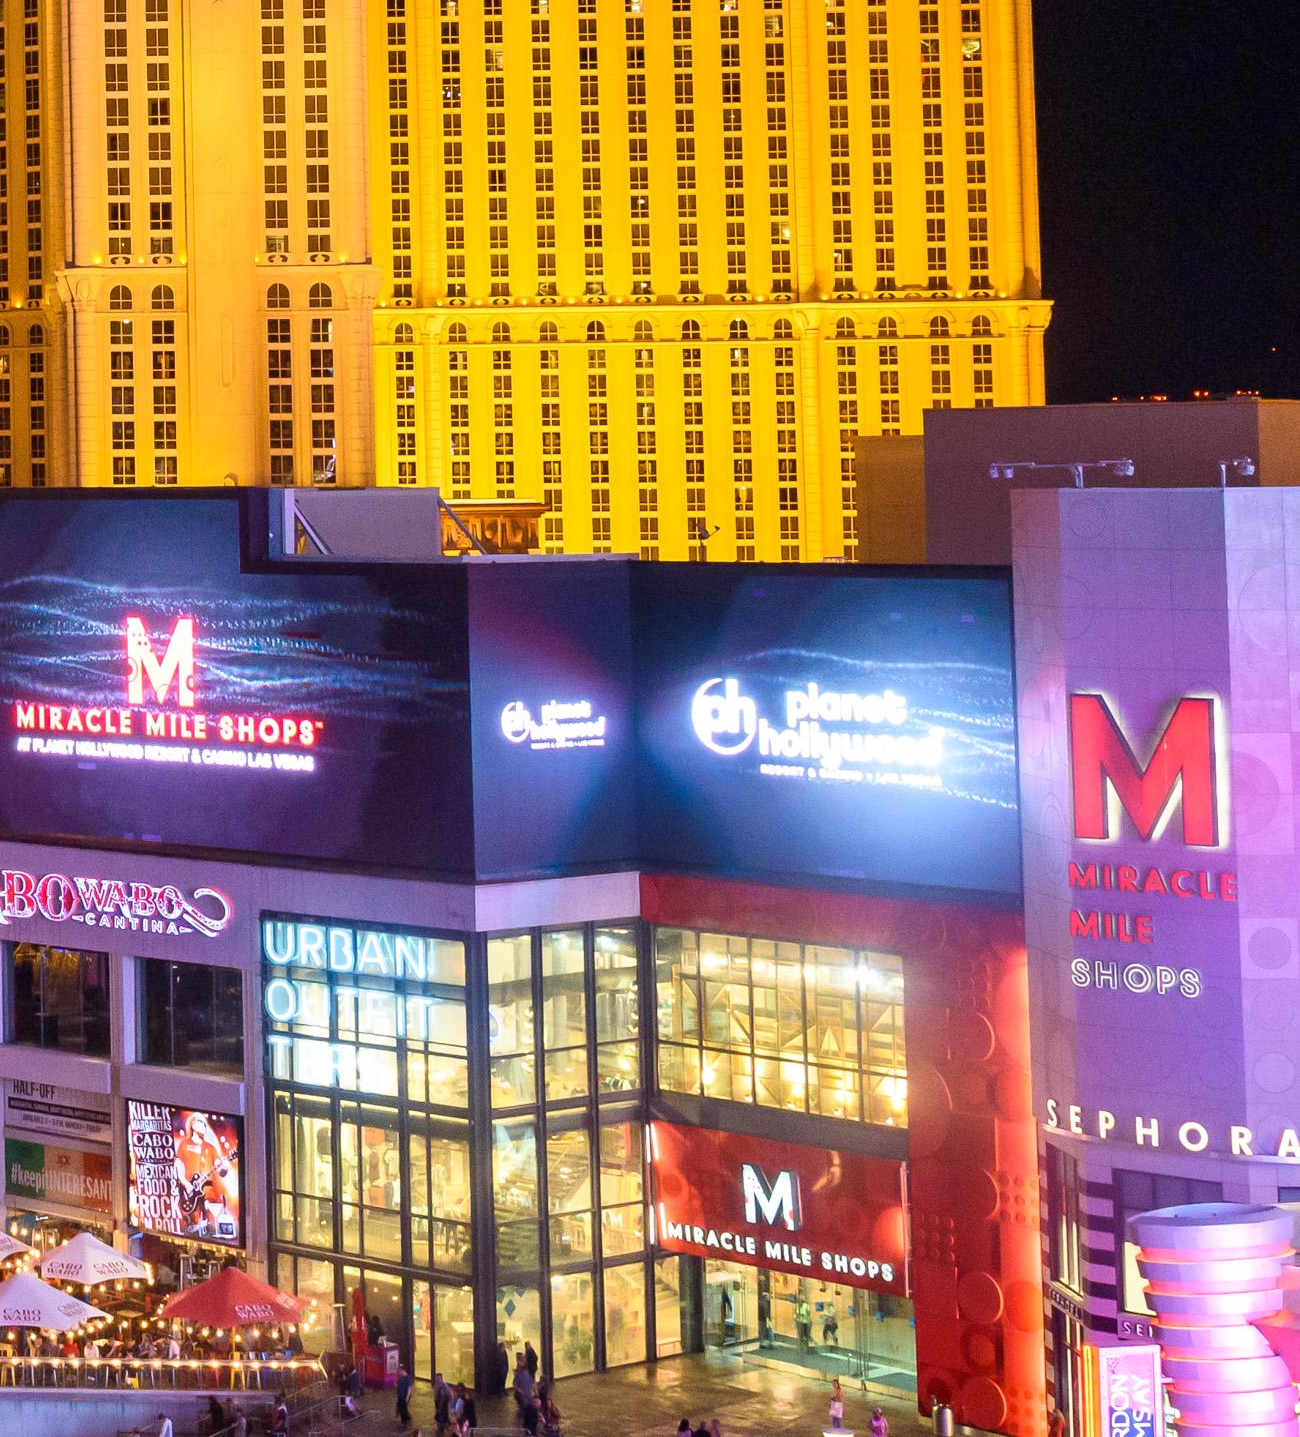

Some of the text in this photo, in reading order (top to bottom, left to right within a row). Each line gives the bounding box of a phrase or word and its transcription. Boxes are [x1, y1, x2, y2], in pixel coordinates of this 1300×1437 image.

[786, 682, 908, 728] planet
[16, 705, 132, 734] MIRACLE
[146, 711, 207, 739] MILE
[758, 718, 945, 770] hollywood
[1070, 694, 1219, 847] M
[1068, 861, 1239, 902] MIRACLE
[85, 913, 179, 935] CANTINA
[1069, 909, 1154, 945] MILE
[263, 921, 427, 980] URBAN
[1071, 957, 1203, 999] SHOPS
[265, 978, 433, 1039] OUTFIT
[13, 1079, 56, 1100] HALF-OFF
[128, 1100, 171, 1120] KILLER
[131, 1118, 172, 1132] MARGARITAS
[1046, 1098, 1300, 1157] SEPHORA
[133, 1134, 173, 1147] CABO
[133, 1146, 175, 1159] WABO
[136, 1164, 179, 1180] MEXICAN
[137, 1179, 180, 1195] FOOD &
[742, 1163, 800, 1231] M
[139, 1194, 183, 1219] ROCK
[155, 1218, 184, 1236] ROLL
[667, 1222, 893, 1282] MIRACLE MILE SHOPS
[47, 1268, 80, 1276] WABO
[93, 1261, 124, 1269] CABO
[96, 1268, 128, 1276] WABO
[235, 1304, 272, 1312] CABO
[236, 1311, 274, 1320] WABO
